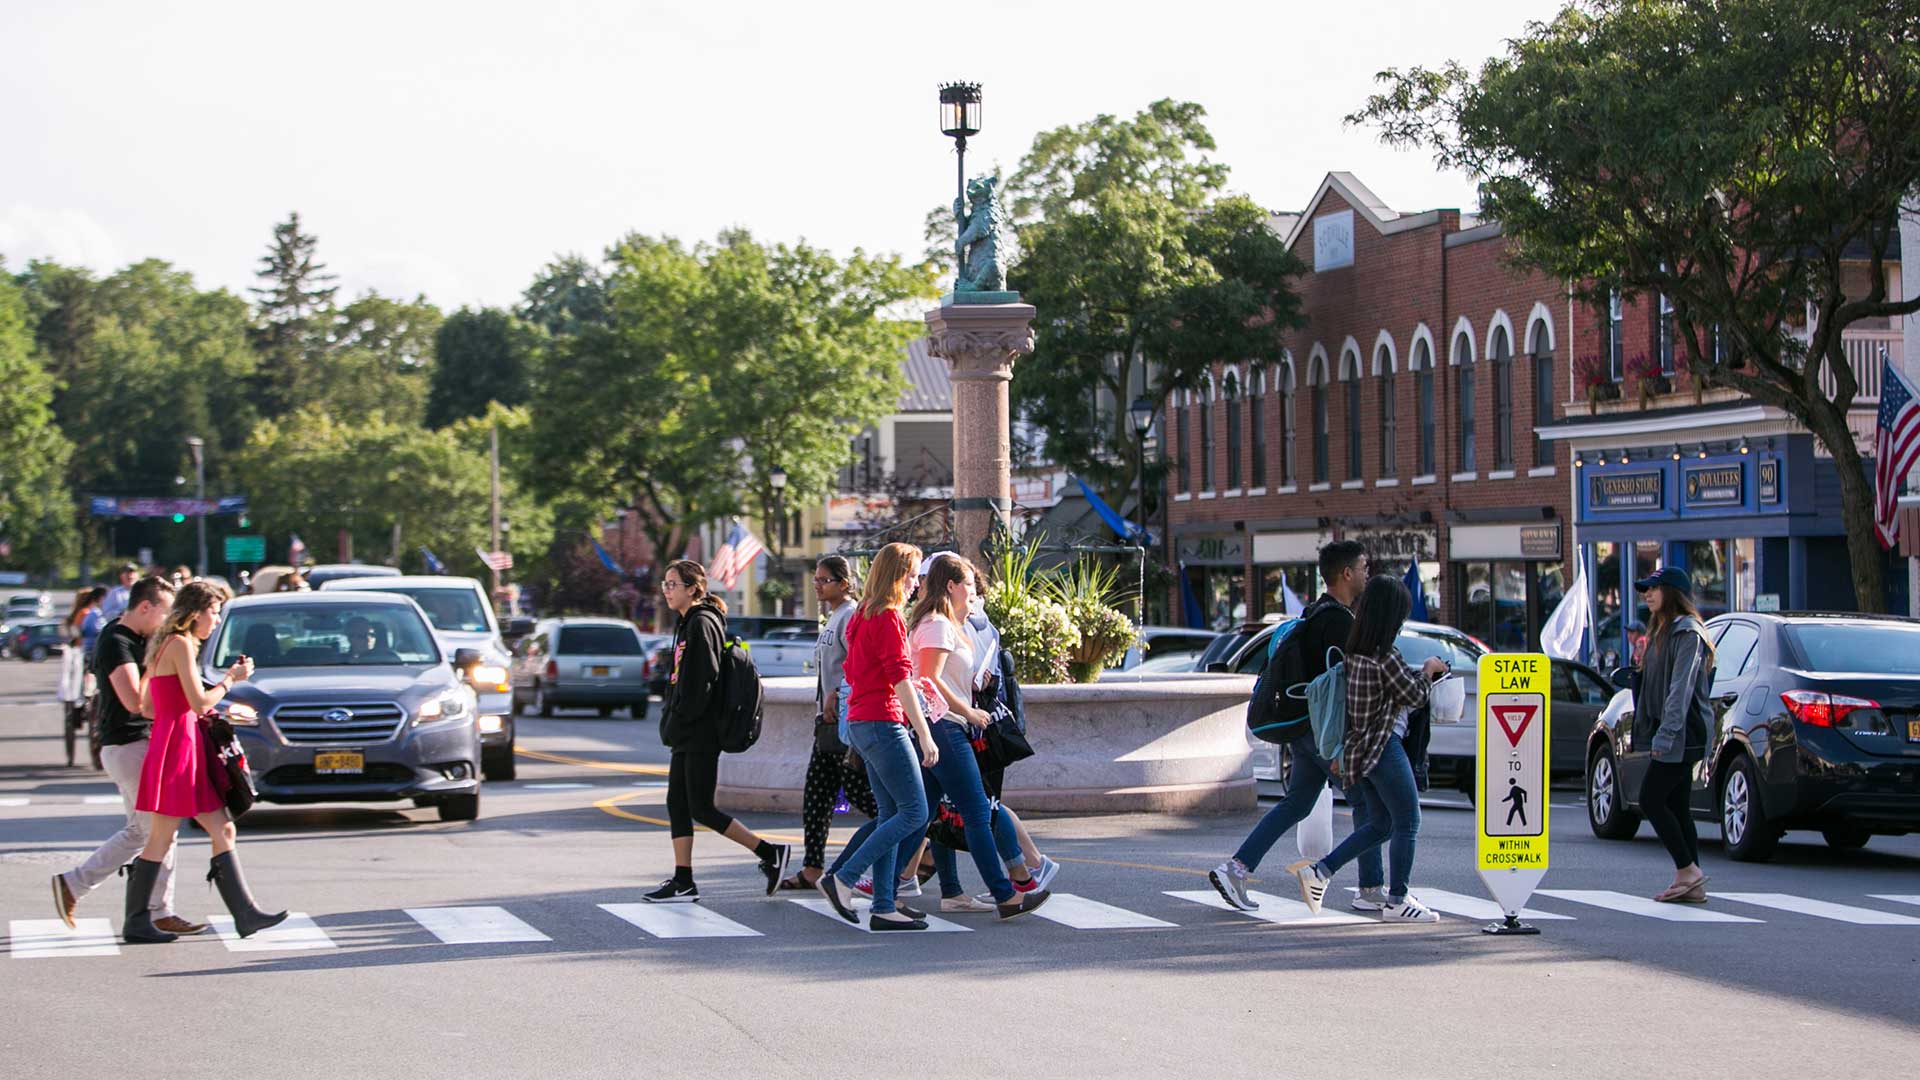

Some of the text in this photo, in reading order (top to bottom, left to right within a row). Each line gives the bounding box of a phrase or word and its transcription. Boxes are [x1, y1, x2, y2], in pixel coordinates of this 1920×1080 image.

[1699, 471, 1739, 487] ROYALTEES
[1761, 467, 1773, 483] 90
[1603, 476, 1659, 495] GENESEO STORE
[1494, 660, 1537, 673] STATE
[1500, 676, 1530, 689] LAW
[1508, 761, 1521, 771] TO
[1498, 840, 1530, 850] WITHIN
[1486, 853, 1541, 864] CROSSWALK
